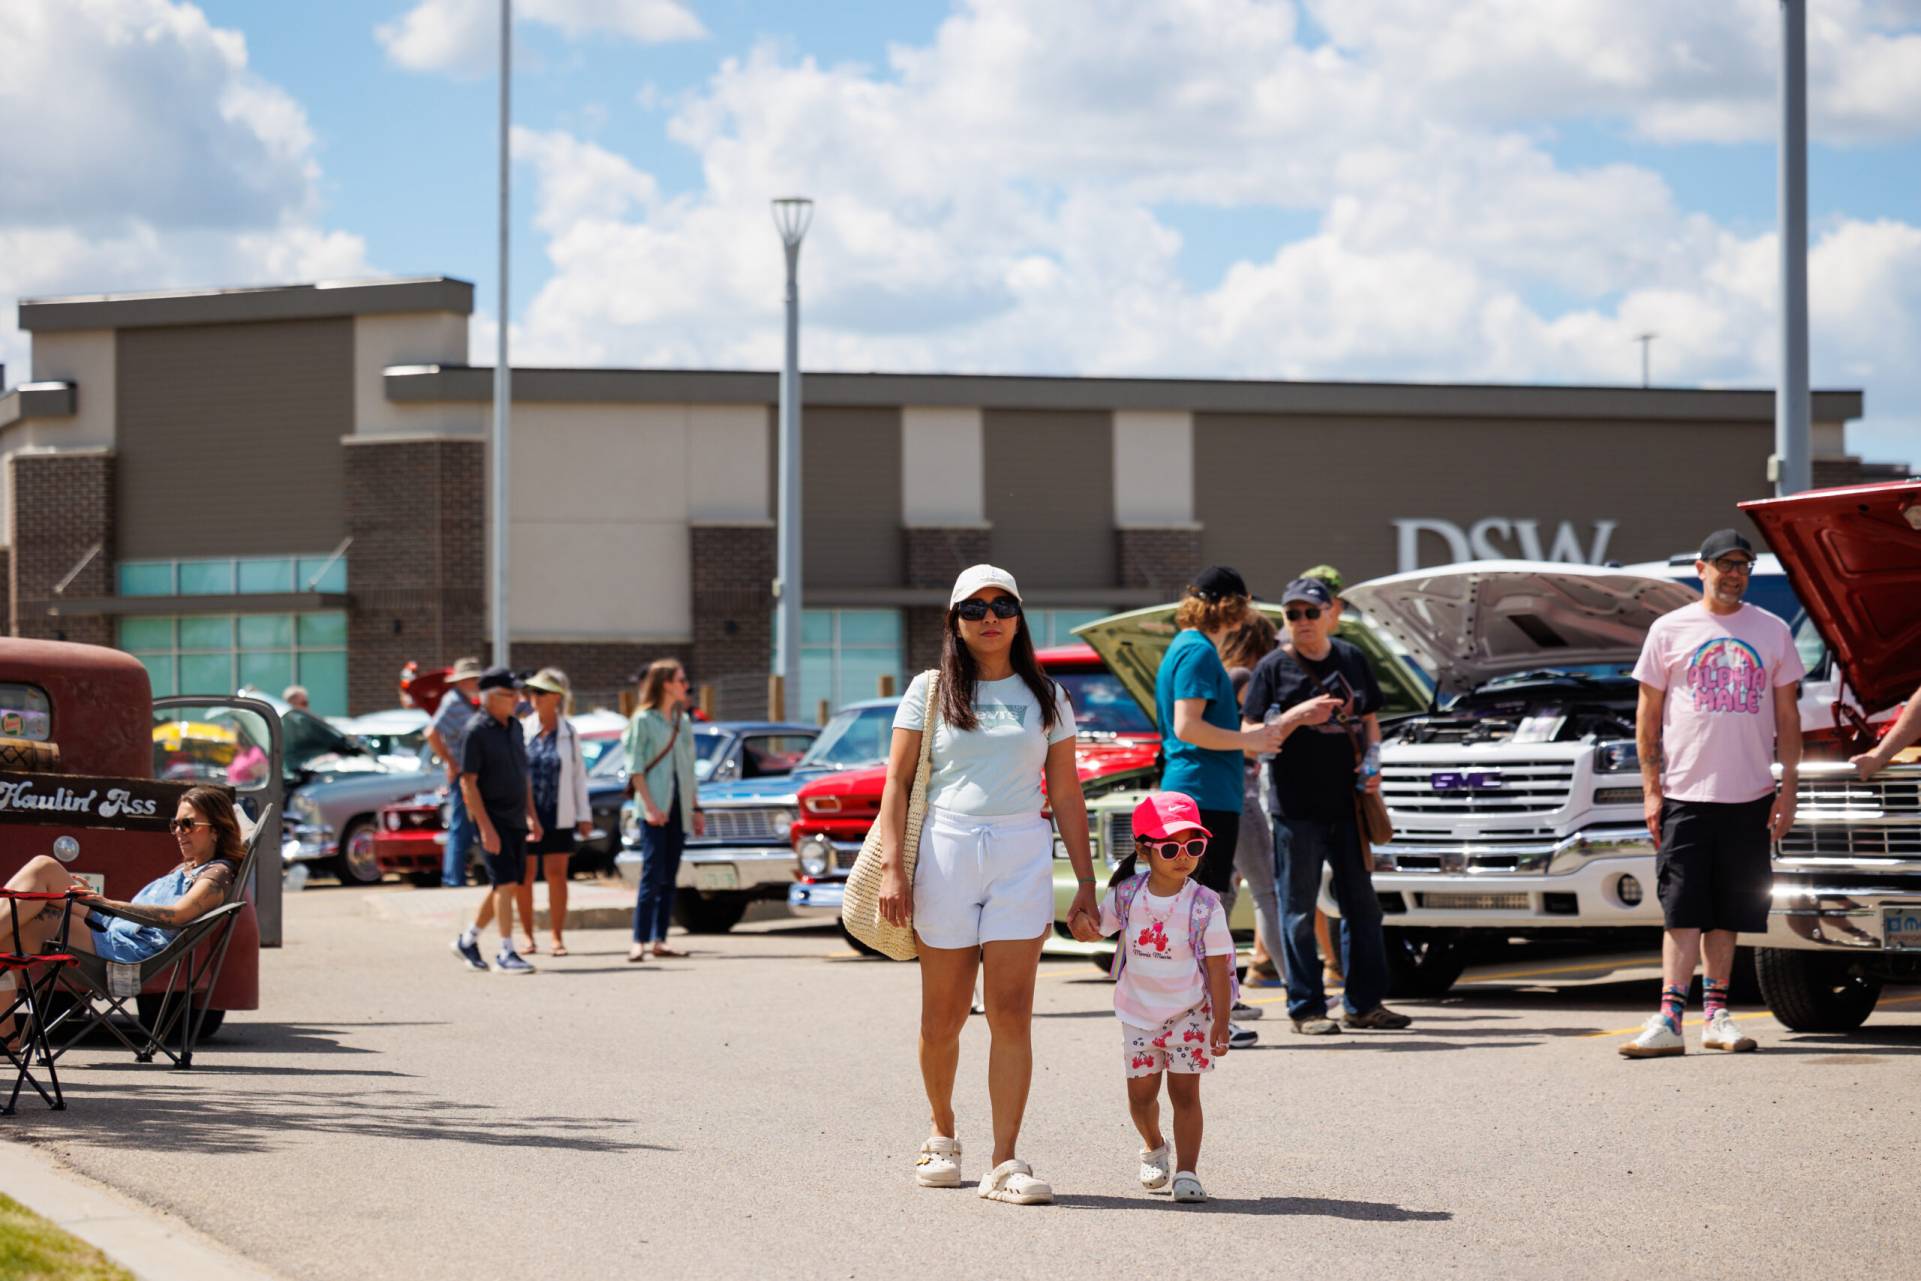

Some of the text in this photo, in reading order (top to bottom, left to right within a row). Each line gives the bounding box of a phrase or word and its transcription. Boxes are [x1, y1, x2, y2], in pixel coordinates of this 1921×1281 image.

[1391, 516, 1618, 574] DSW
[1687, 665, 1767, 691] ALPHA
[1695, 688, 1760, 715] MALE
[98, 788, 157, 818] Ass
